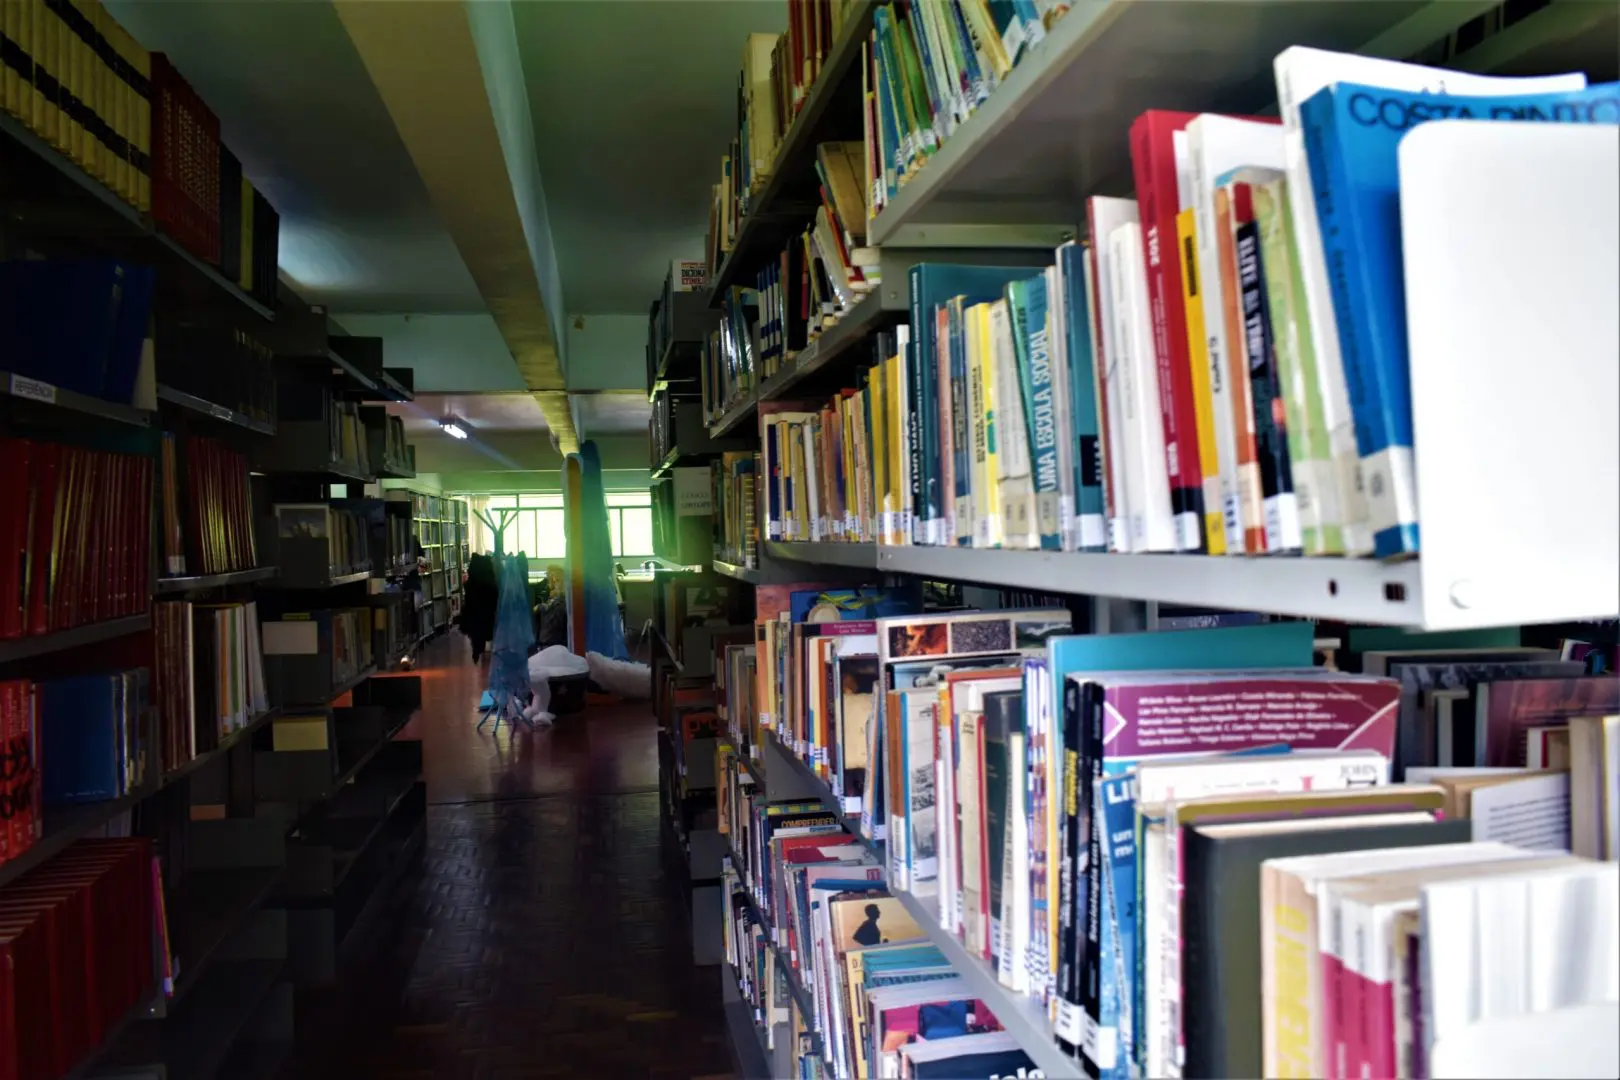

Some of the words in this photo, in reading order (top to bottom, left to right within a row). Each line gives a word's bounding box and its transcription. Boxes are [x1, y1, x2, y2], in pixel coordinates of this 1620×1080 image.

[1029, 329, 1052, 386] SOCIAL
[1033, 388, 1054, 449] ESCOLA
[1036, 451, 1057, 492] UMA
